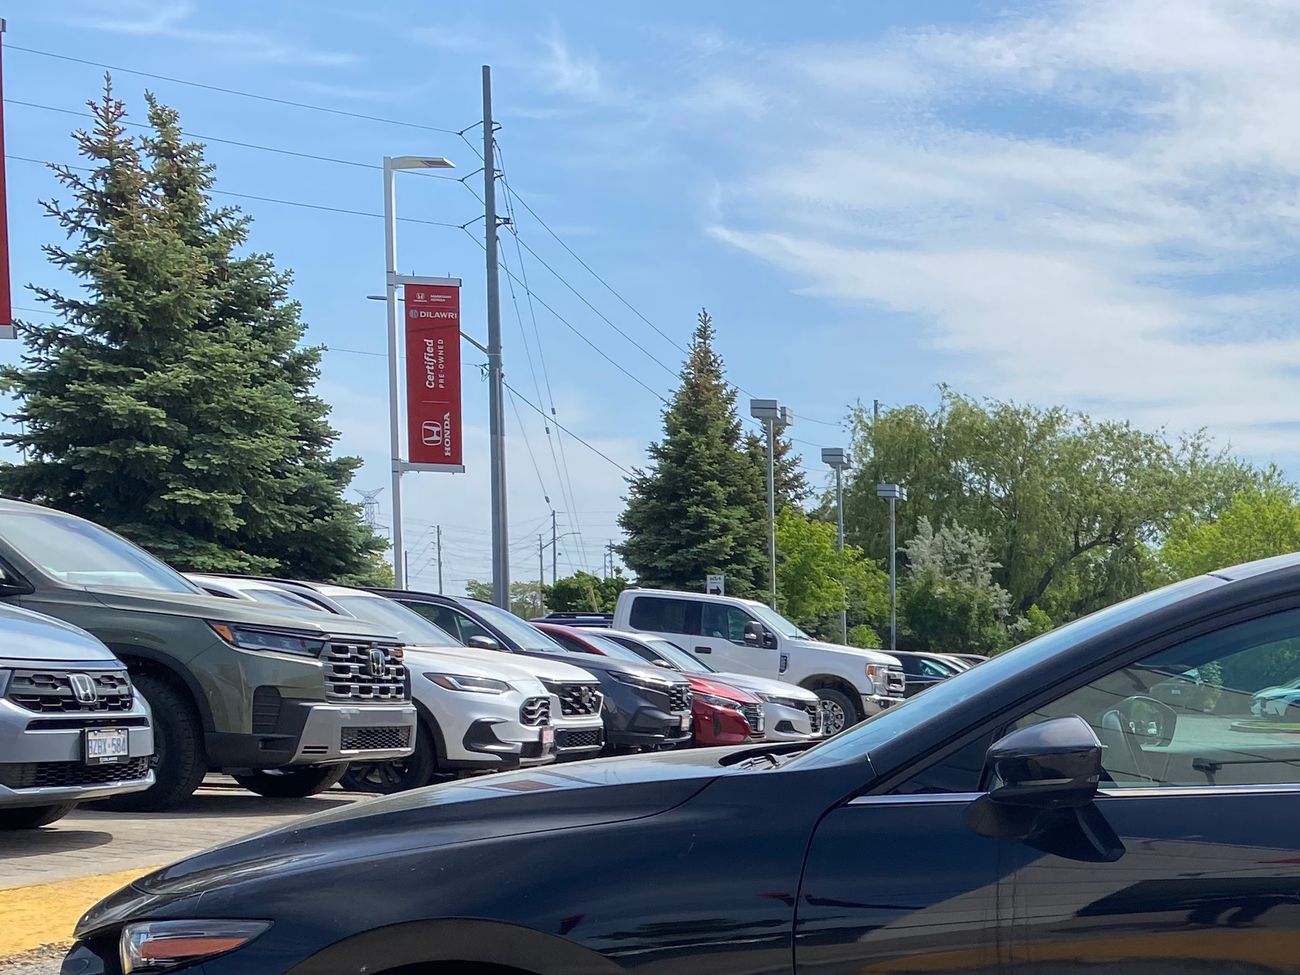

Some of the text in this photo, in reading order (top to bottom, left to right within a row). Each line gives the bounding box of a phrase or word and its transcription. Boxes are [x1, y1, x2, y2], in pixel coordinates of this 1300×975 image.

[420, 311, 458, 319] DILAWRI
[423, 339, 437, 389] Certified
[443, 412, 451, 456] HONDA
